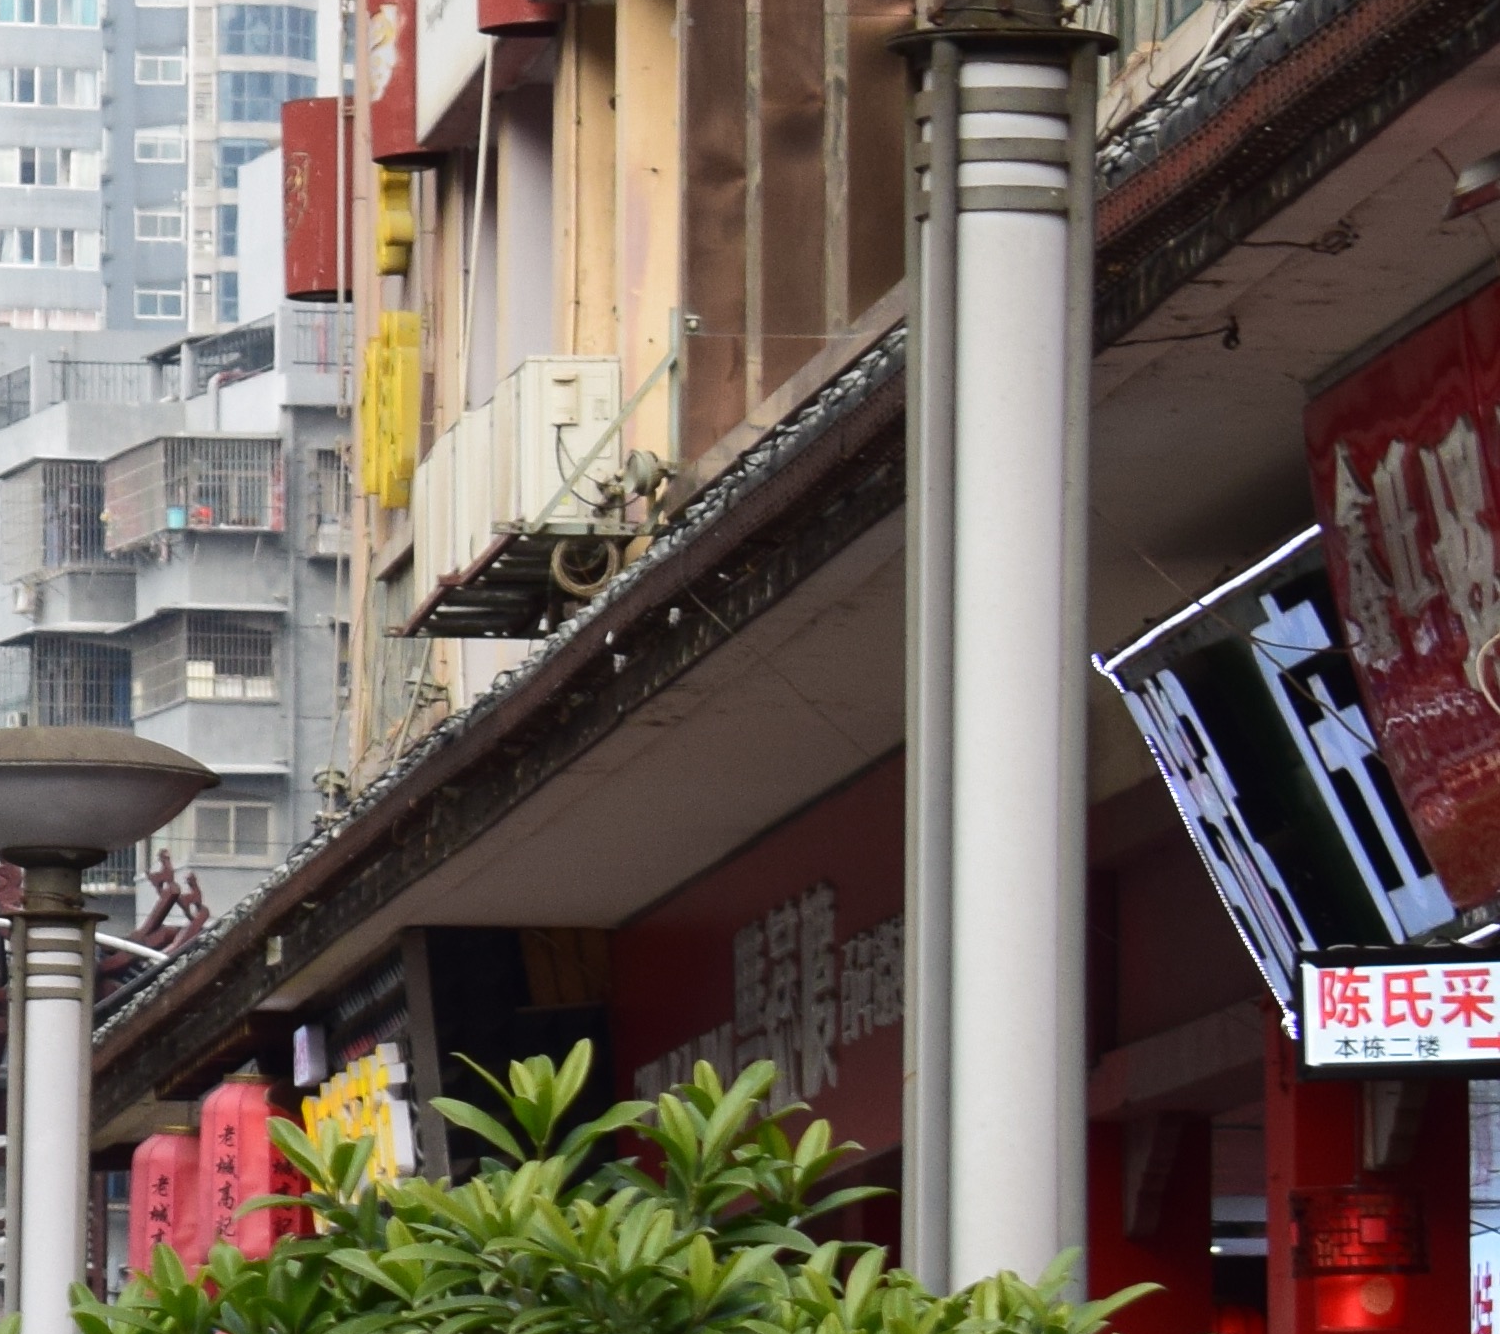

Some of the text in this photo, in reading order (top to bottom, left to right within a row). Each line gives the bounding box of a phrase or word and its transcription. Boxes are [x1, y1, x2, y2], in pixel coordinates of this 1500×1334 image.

[1317, 967, 1496, 1032] 陈氏采
[1334, 1034, 1443, 1059] 本栋二楼
